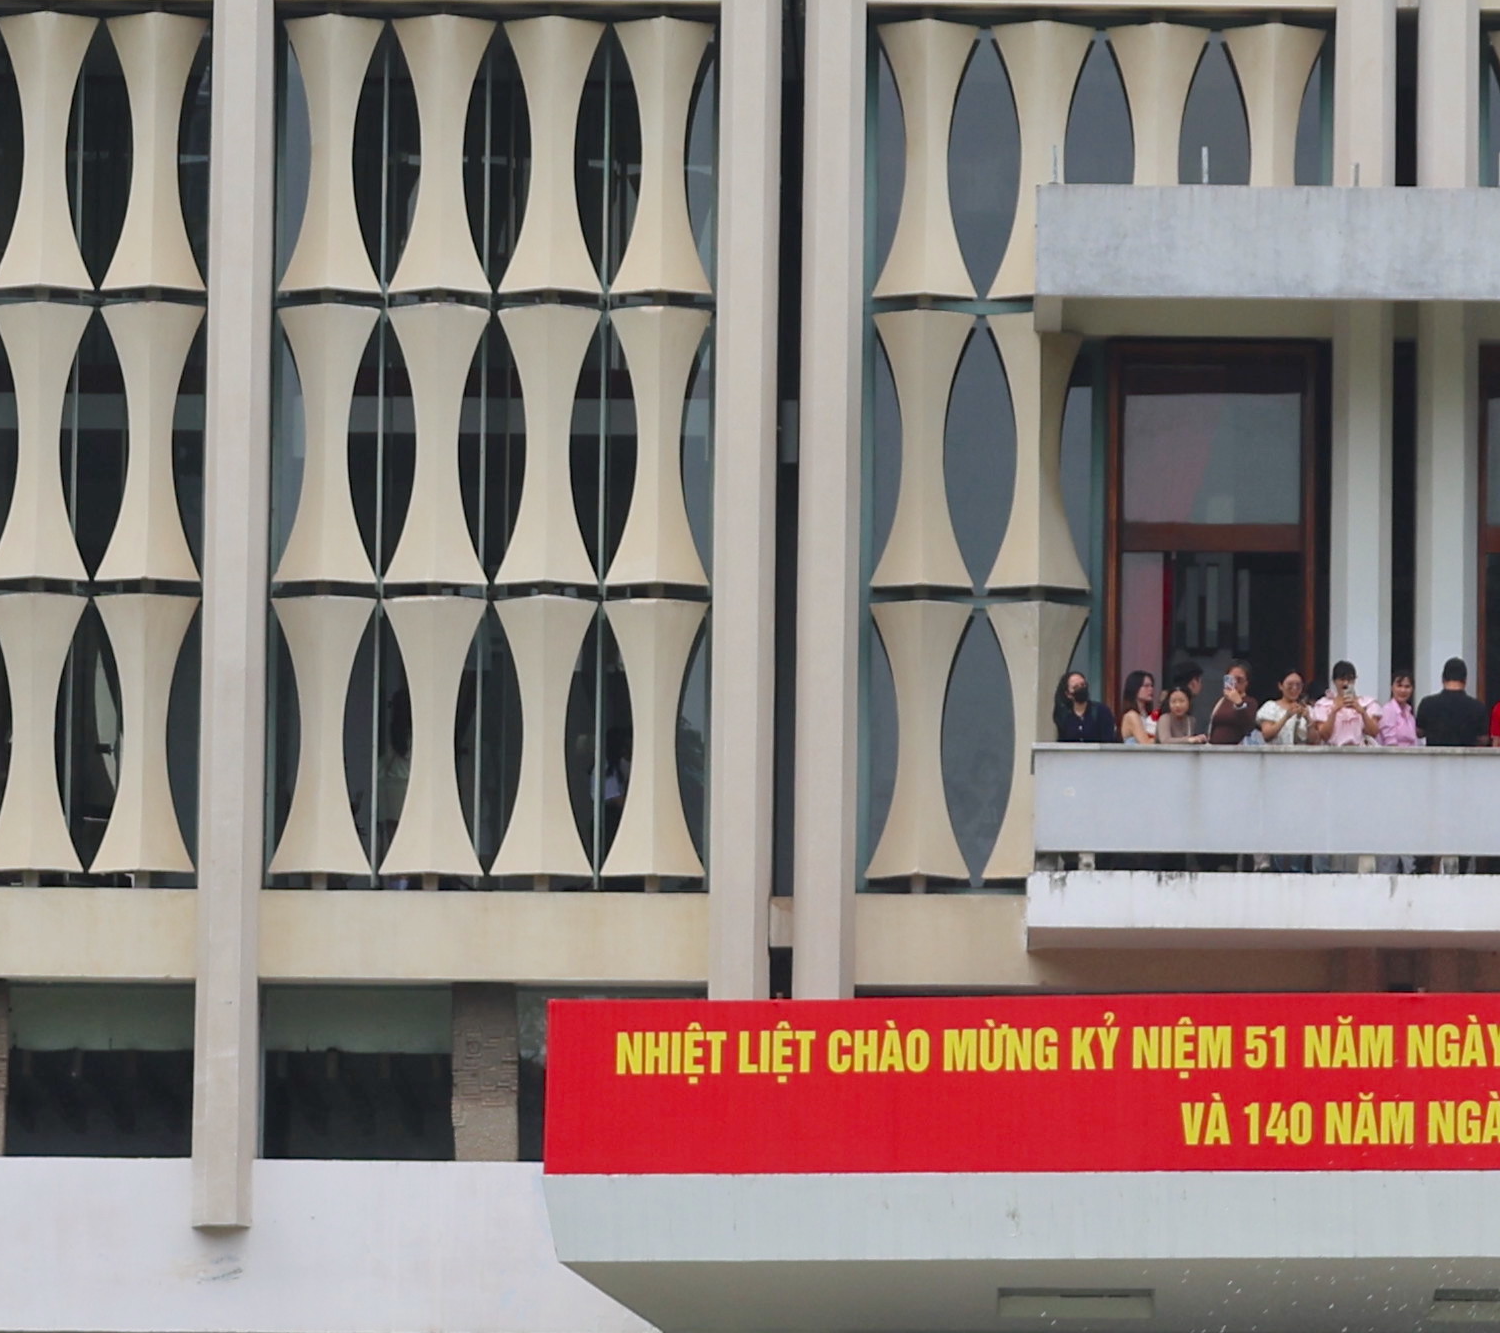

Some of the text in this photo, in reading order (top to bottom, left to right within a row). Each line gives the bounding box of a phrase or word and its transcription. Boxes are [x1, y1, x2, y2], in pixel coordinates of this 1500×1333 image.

[616, 1022, 728, 1085] NHIỆT
[738, 1021, 817, 1084] LIỆT
[827, 1021, 931, 1074] CHÀO
[943, 1017, 1059, 1072] MỪNG
[1071, 1012, 1121, 1070] KỶ
[1132, 1016, 1233, 1079] NIỆM
[1244, 1025, 1286, 1069] 51
[1303, 1016, 1394, 1069] NĂM
[1181, 1093, 1231, 1146] VÀ
[1243, 1101, 1313, 1146] 140
[1324, 1093, 1415, 1145] NĂM
